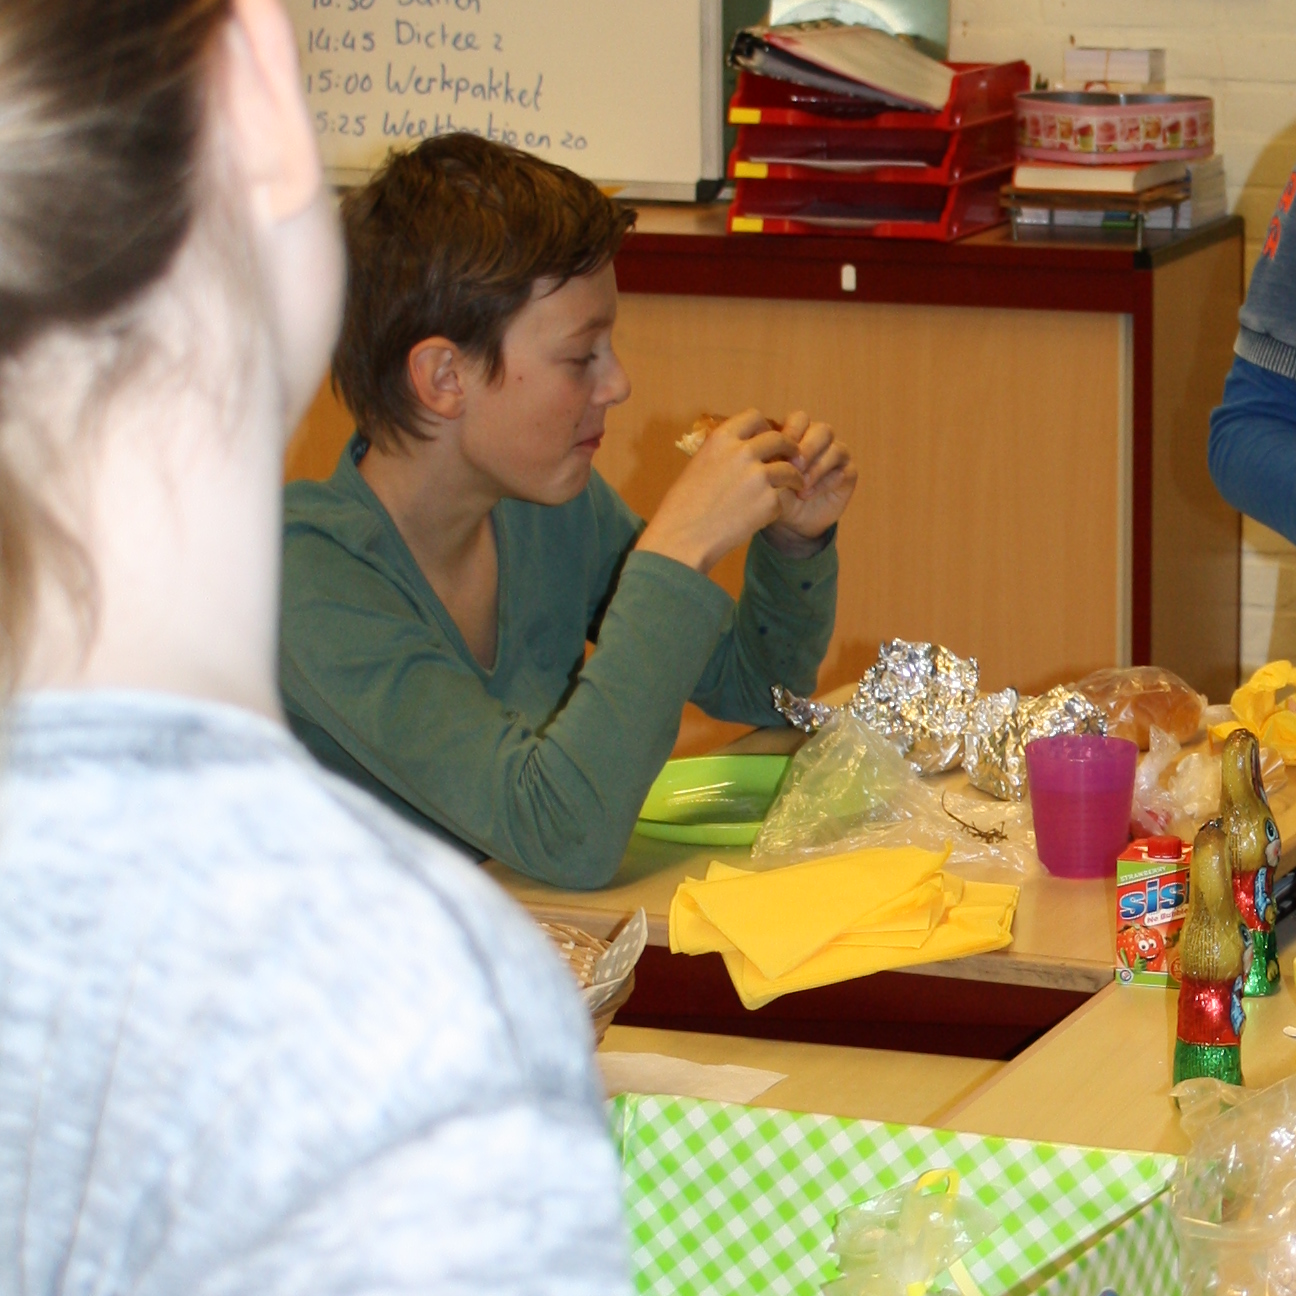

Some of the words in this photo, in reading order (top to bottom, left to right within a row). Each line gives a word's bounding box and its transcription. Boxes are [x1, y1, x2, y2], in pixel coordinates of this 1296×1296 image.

[307, 27, 376, 53] 14:45
[394, 19, 480, 51] Dictee
[306, 68, 374, 95] 15:00
[385, 62, 544, 112] Werkpakket
[315, 110, 367, 137] 5:25
